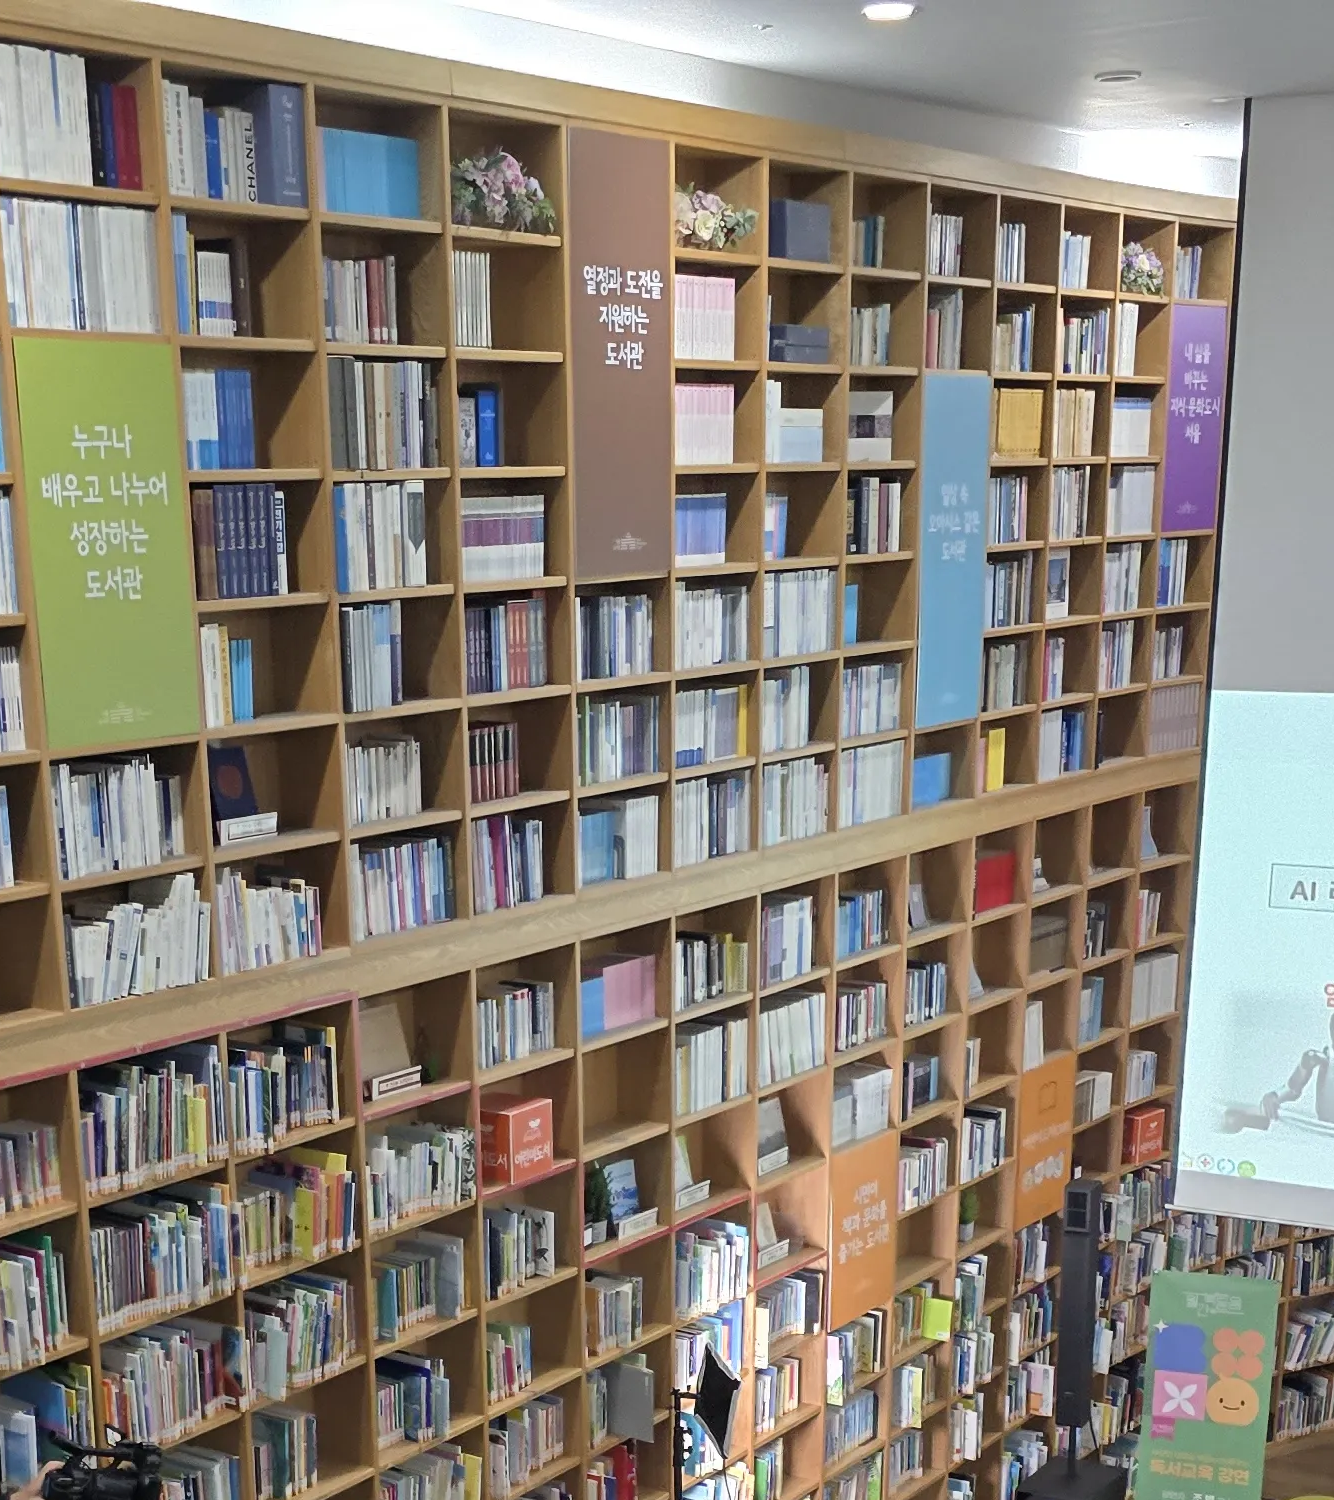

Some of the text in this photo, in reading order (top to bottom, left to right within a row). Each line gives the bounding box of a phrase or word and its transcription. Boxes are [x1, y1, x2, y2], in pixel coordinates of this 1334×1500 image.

[244, 122, 257, 203] CHANEL
[582, 264, 664, 300] 열정과 도전을
[598, 303, 650, 334] 지원하는
[605, 340, 645, 370] 도서관
[71, 424, 132, 459] 누구나
[41, 471, 168, 508] 배우고 나누어
[70, 519, 149, 556] 성장하는
[85, 566, 143, 600] 도서관
[1289, 880, 1317, 901] AI
